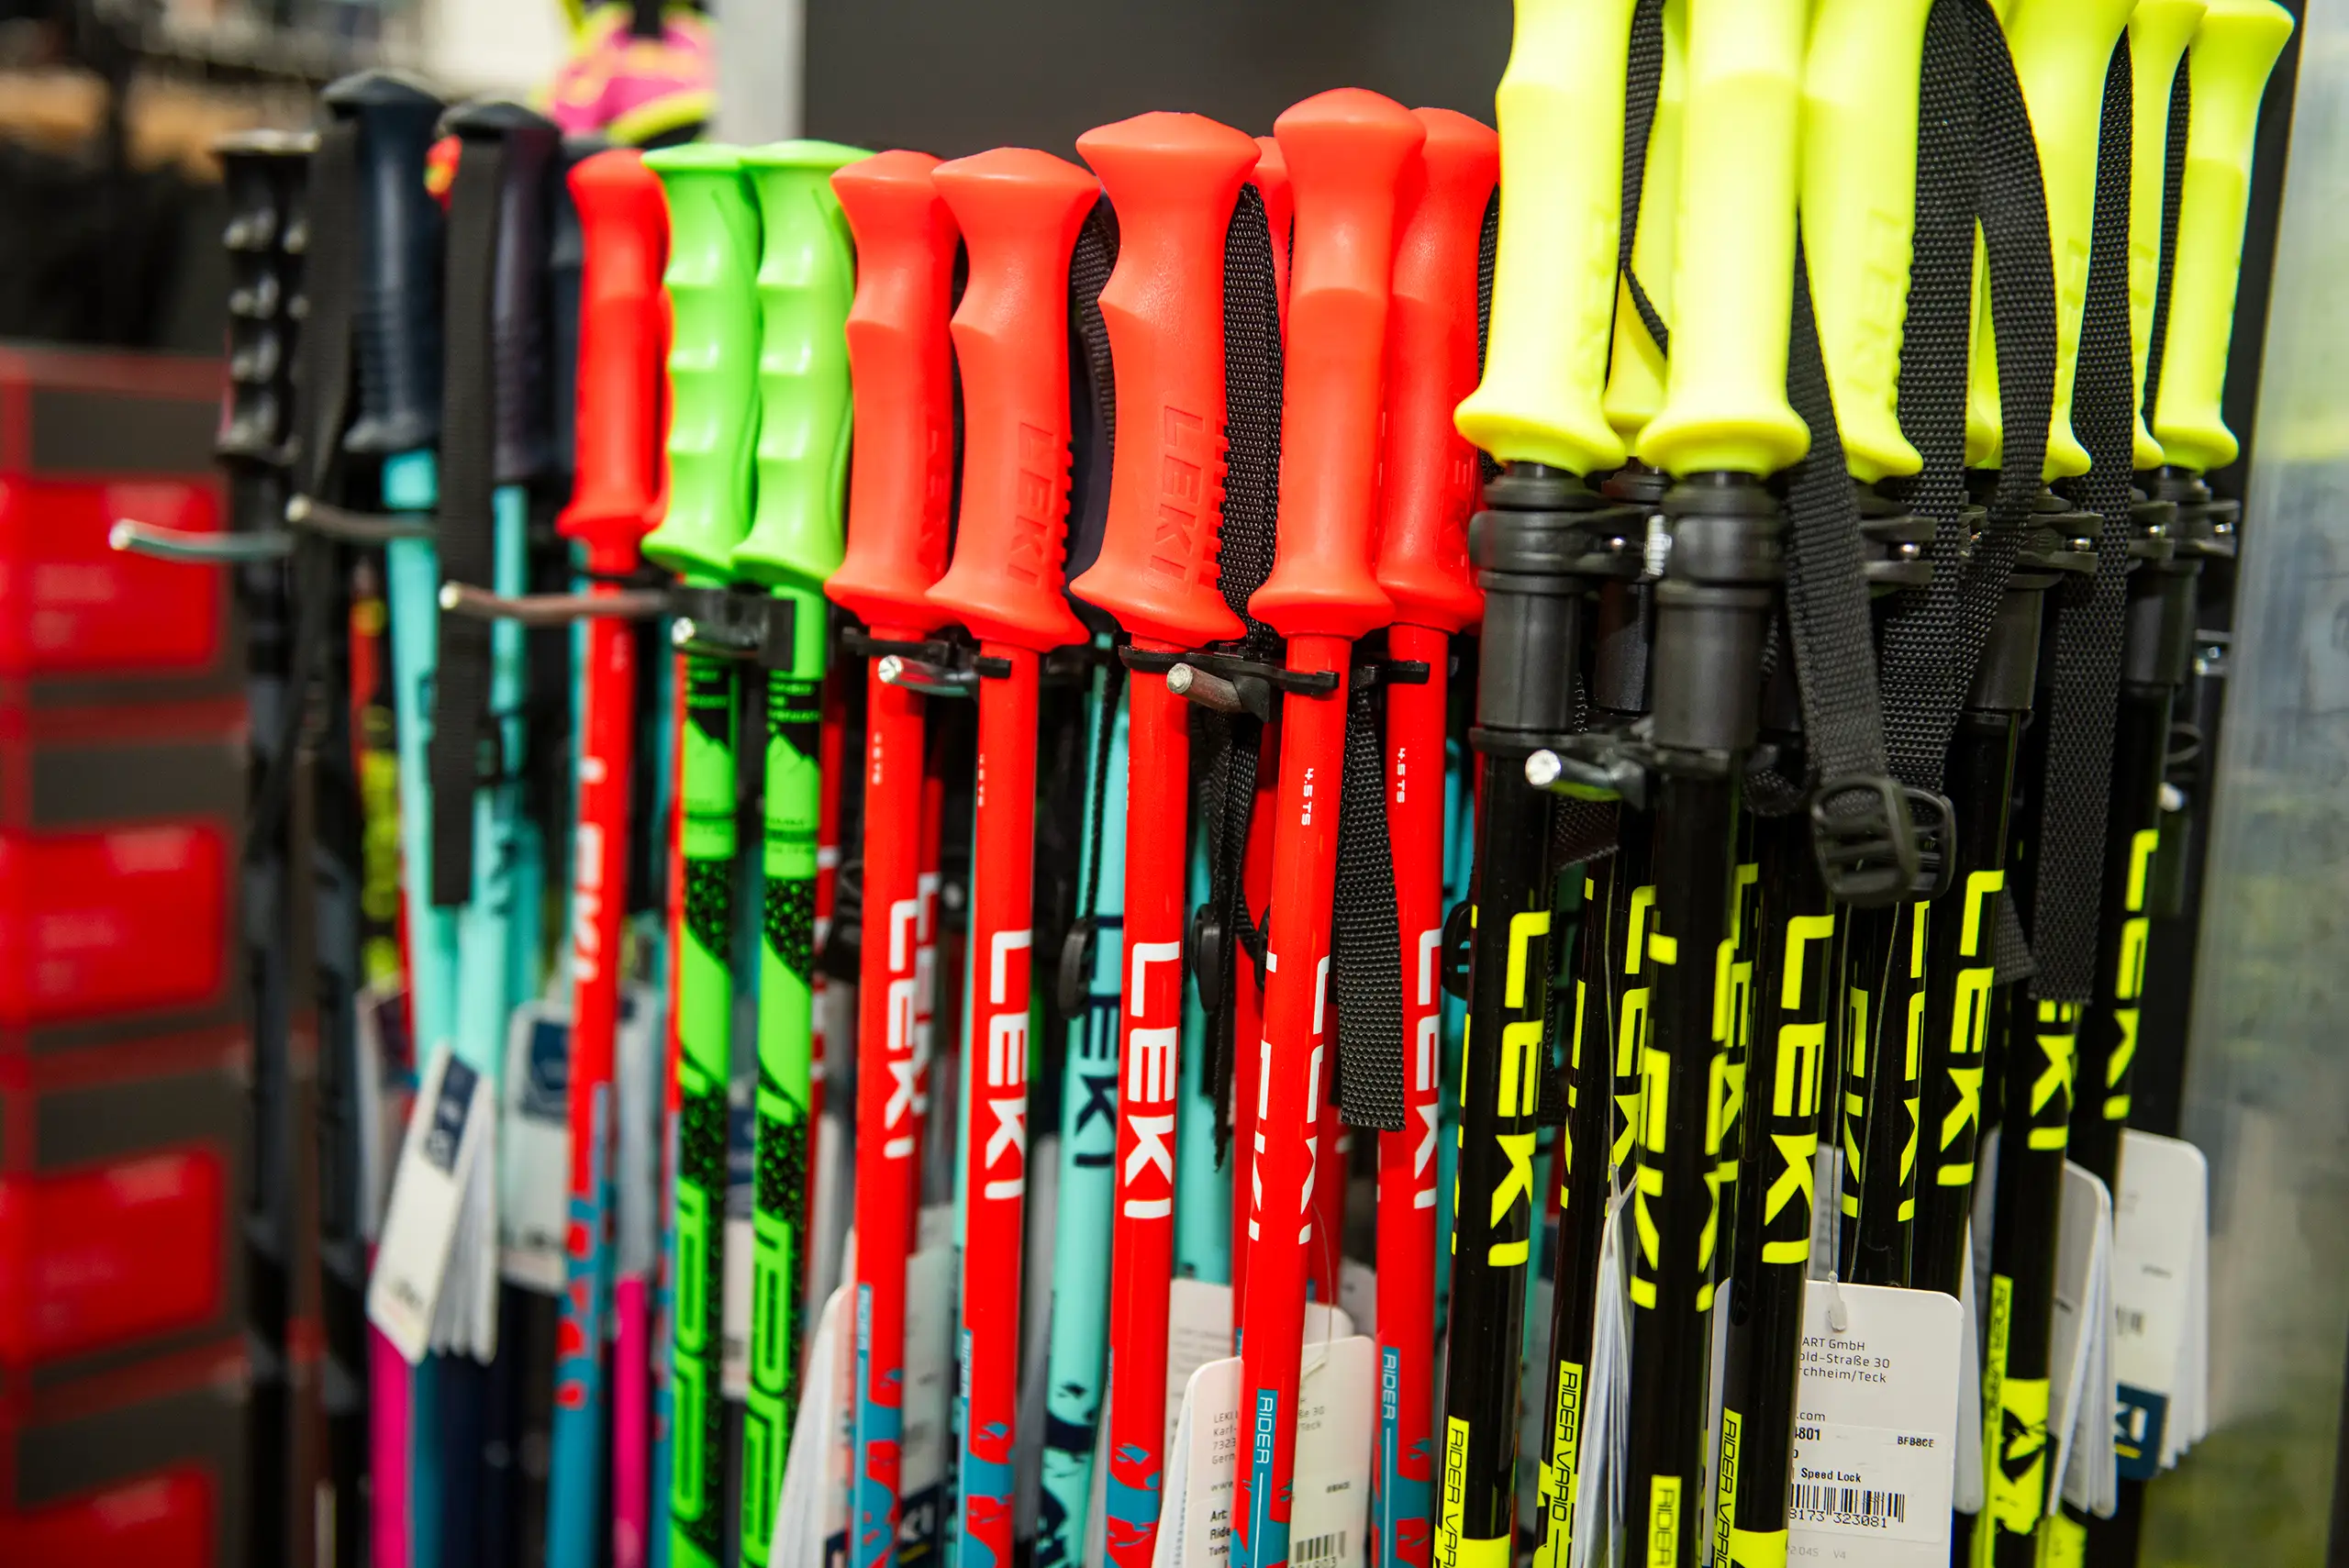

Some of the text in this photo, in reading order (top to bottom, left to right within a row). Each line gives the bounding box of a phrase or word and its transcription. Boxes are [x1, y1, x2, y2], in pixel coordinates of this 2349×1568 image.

[1008, 422, 1055, 588] LEKI
[1150, 405, 1205, 582] LEKI
[1301, 768, 1314, 826] 4.5 TS
[1397, 747, 1406, 803] 4.5 TS
[2103, 829, 2159, 1118] LEKI
[885, 898, 918, 1158] LEKI
[985, 929, 1030, 1199] LEKI
[1937, 870, 2004, 1185] LEKI
[1120, 940, 1180, 1218] LEKI
[1414, 929, 1442, 1209] LEKI
[1487, 912, 1551, 1266] LEKI
[1762, 915, 1834, 1263] LEKI
[1829, 1339, 1865, 1351] GmbH
[1874, 1357, 1890, 1369] 30
[1383, 1353, 1397, 1420] RIDER
[1796, 1410, 1826, 1422] .com
[1213, 1438, 1236, 1451] 7323
[1256, 1396, 1274, 1464] RIDER
[1447, 1428, 1464, 1505] RIDER
[1553, 1371, 1577, 1522] RIDER VARIO
[1721, 1418, 1738, 1495] RIDER
[1800, 1467, 1862, 1484] Speed Lock
[1209, 1527, 1230, 1540] Ride
[1654, 1488, 1675, 1566] RIDER
[1832, 1511, 1887, 1529] 323081
